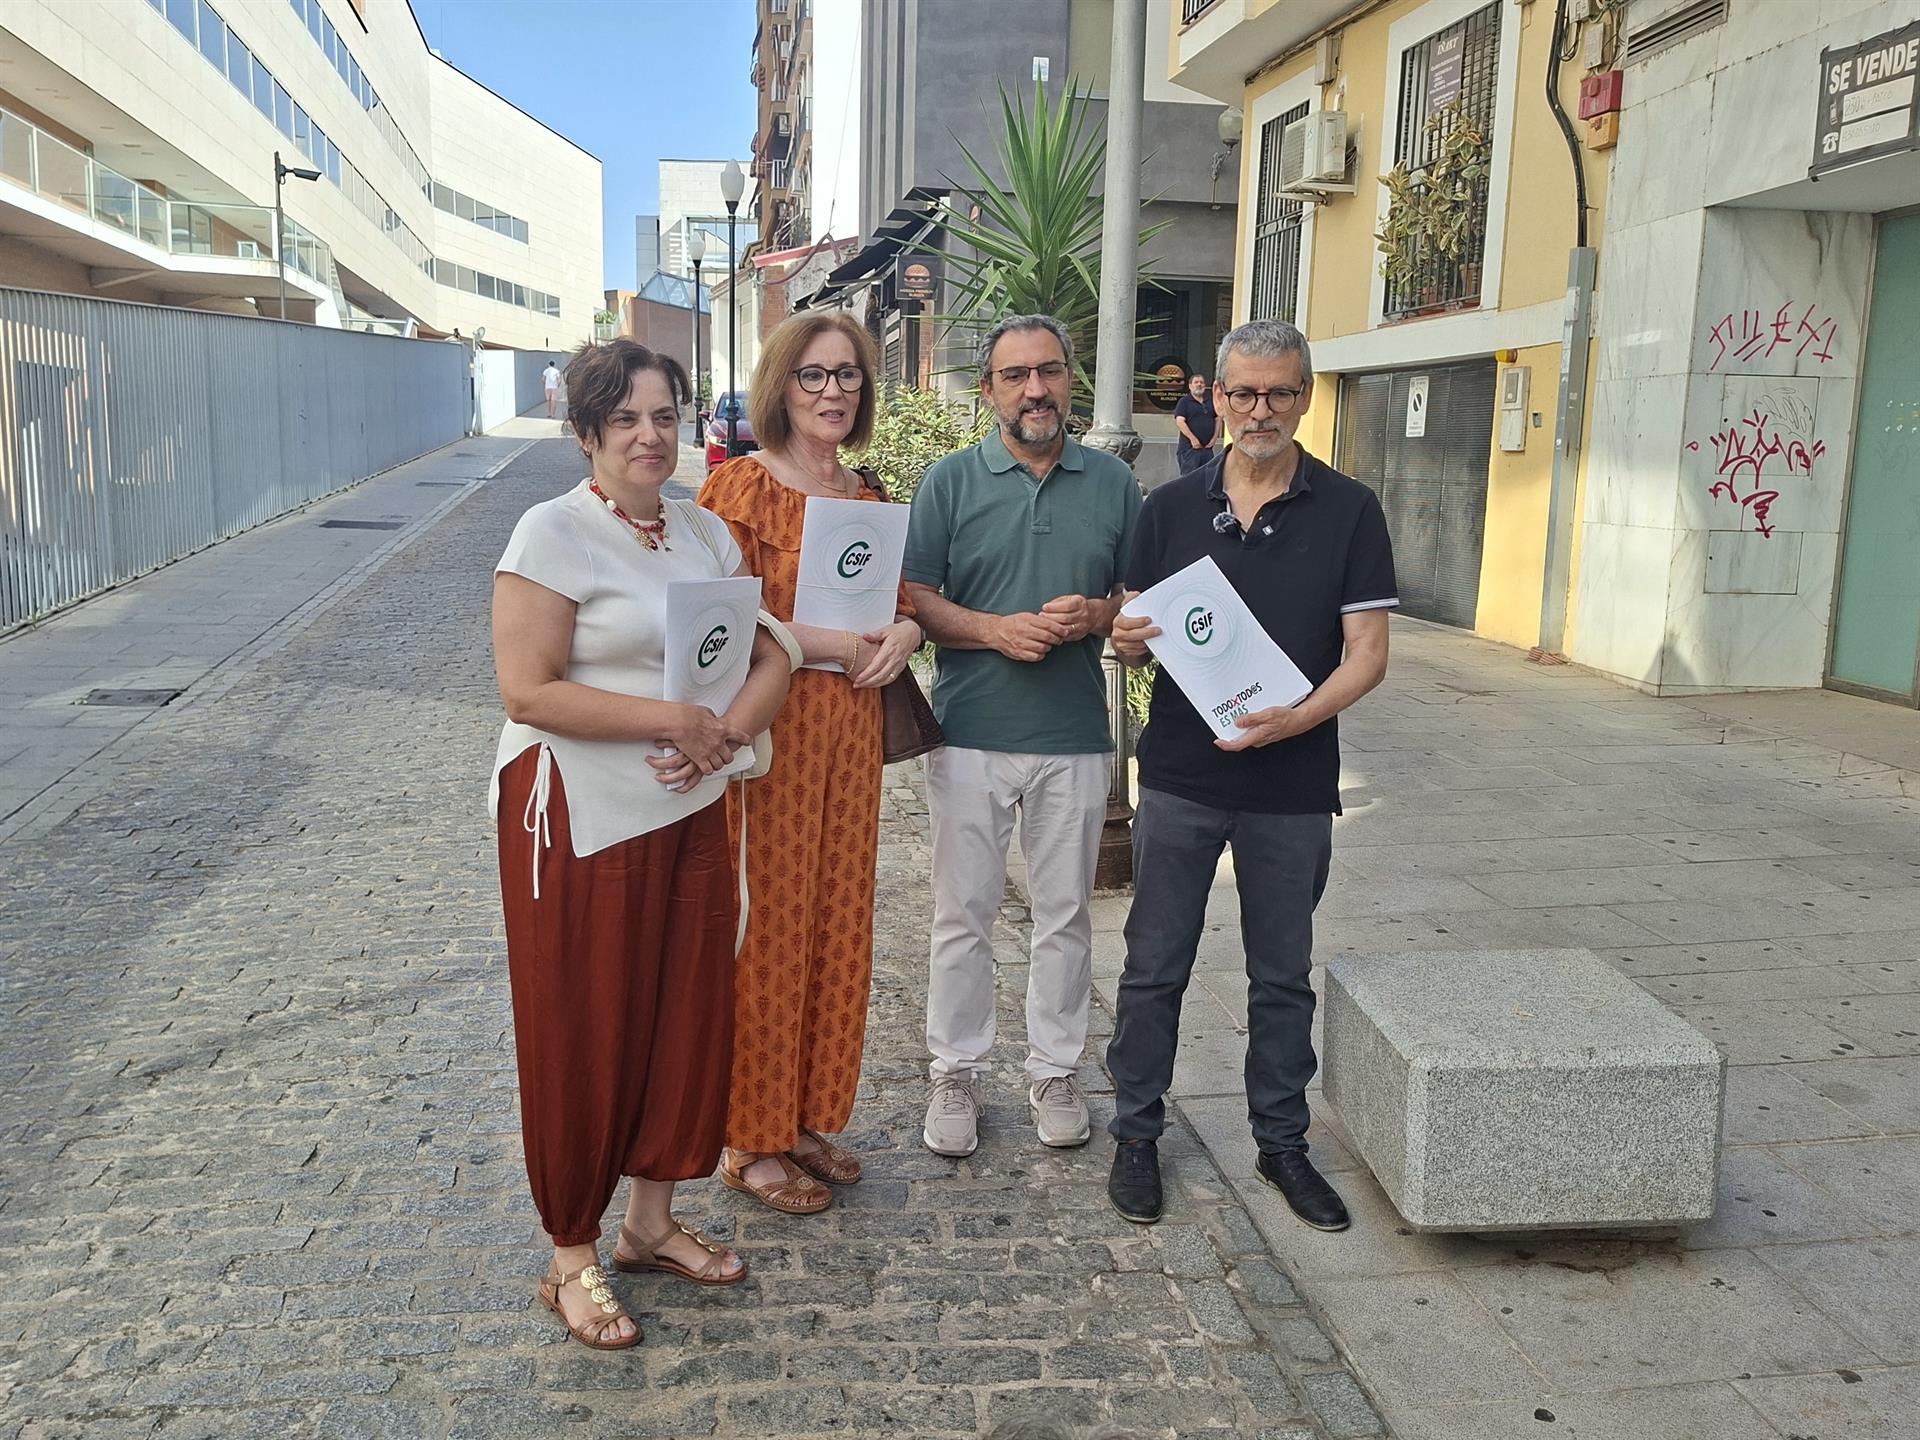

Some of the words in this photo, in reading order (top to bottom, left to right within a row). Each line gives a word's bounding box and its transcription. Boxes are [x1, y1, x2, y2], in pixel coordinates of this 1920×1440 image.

[1829, 61, 1853, 94] SE
[1856, 38, 1920, 86] VENDE
[845, 552, 872, 566] CSIF
[1191, 612, 1214, 635] CSIF
[704, 636, 729, 654] CSIF
[1219, 714, 1231, 728] ES
